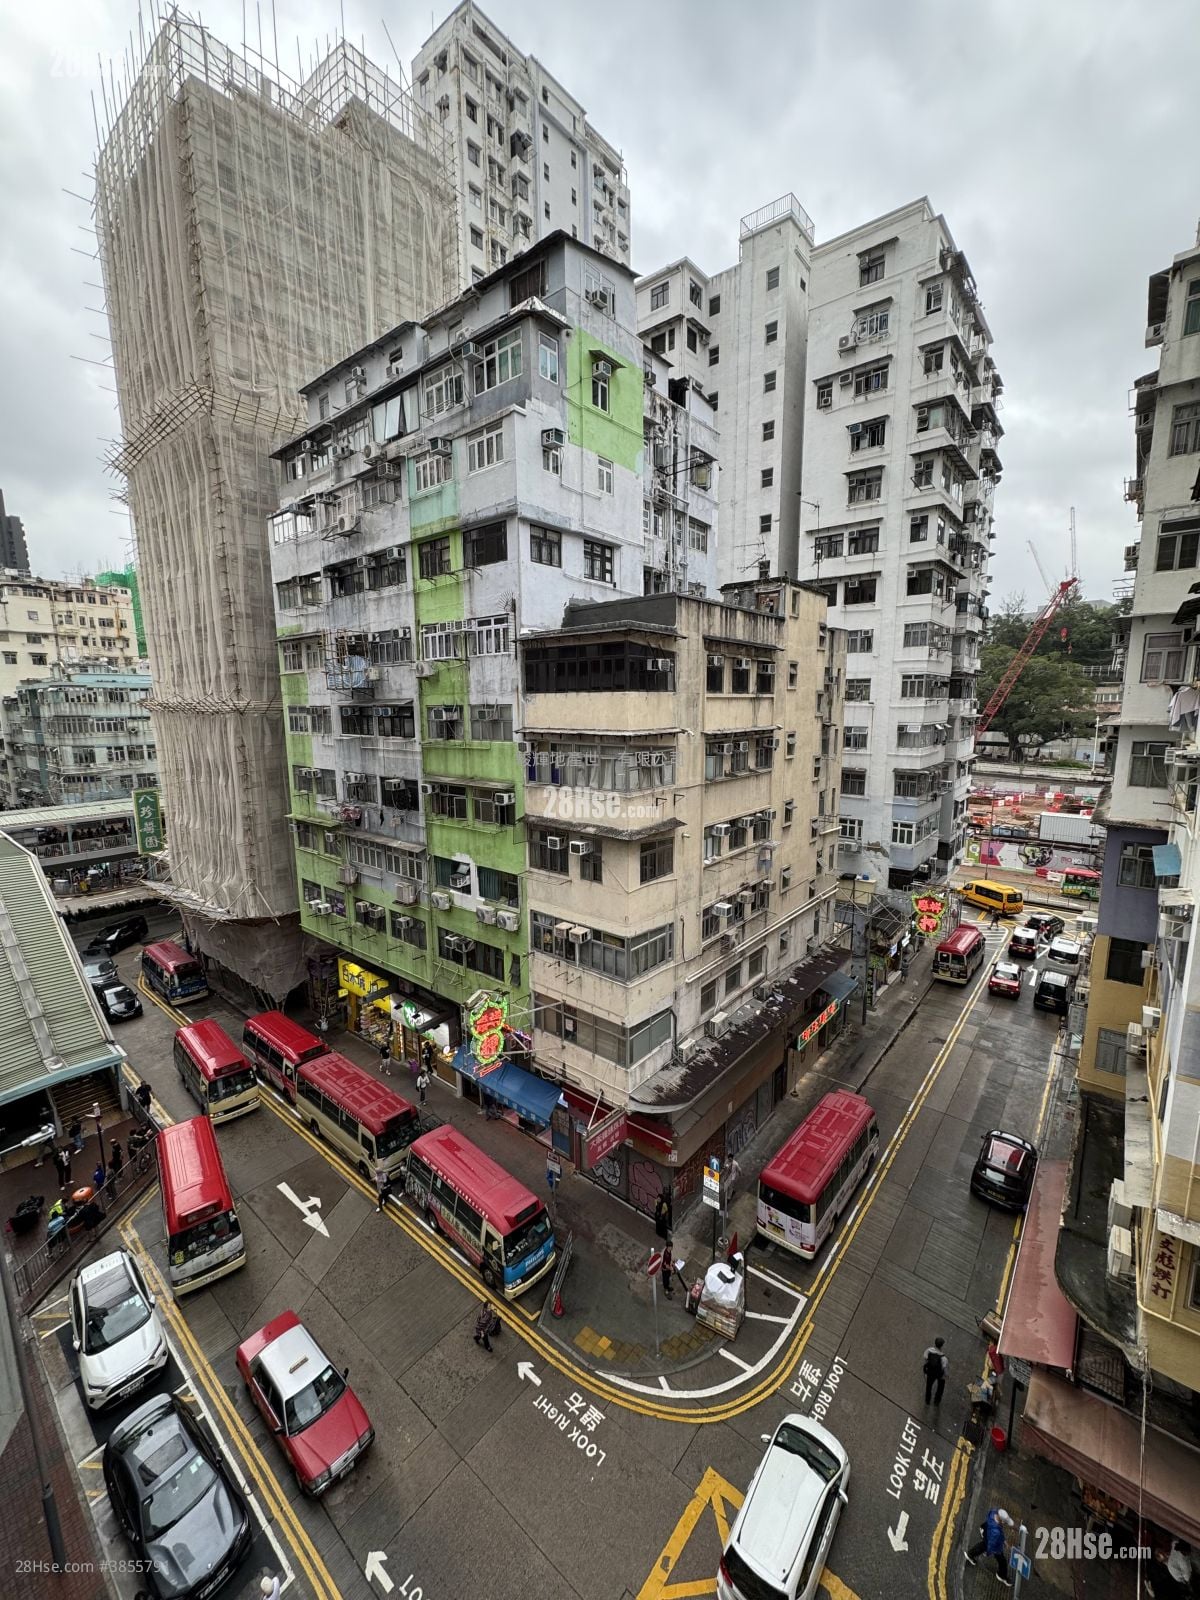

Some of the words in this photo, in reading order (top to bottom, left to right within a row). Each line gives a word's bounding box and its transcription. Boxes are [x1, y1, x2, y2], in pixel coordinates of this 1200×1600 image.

[790, 1359, 822, 1402] 望右
[823, 1355, 849, 1395] LOOK
[532, 1394, 571, 1431] RIGHT
[563, 1391, 607, 1432] 望右
[808, 1393, 833, 1426] RIGH
[566, 1425, 607, 1468] LOOK
[886, 1452, 911, 1500] LOOK
[901, 1417, 922, 1454] LEFT
[912, 1447, 945, 1506] 望左
